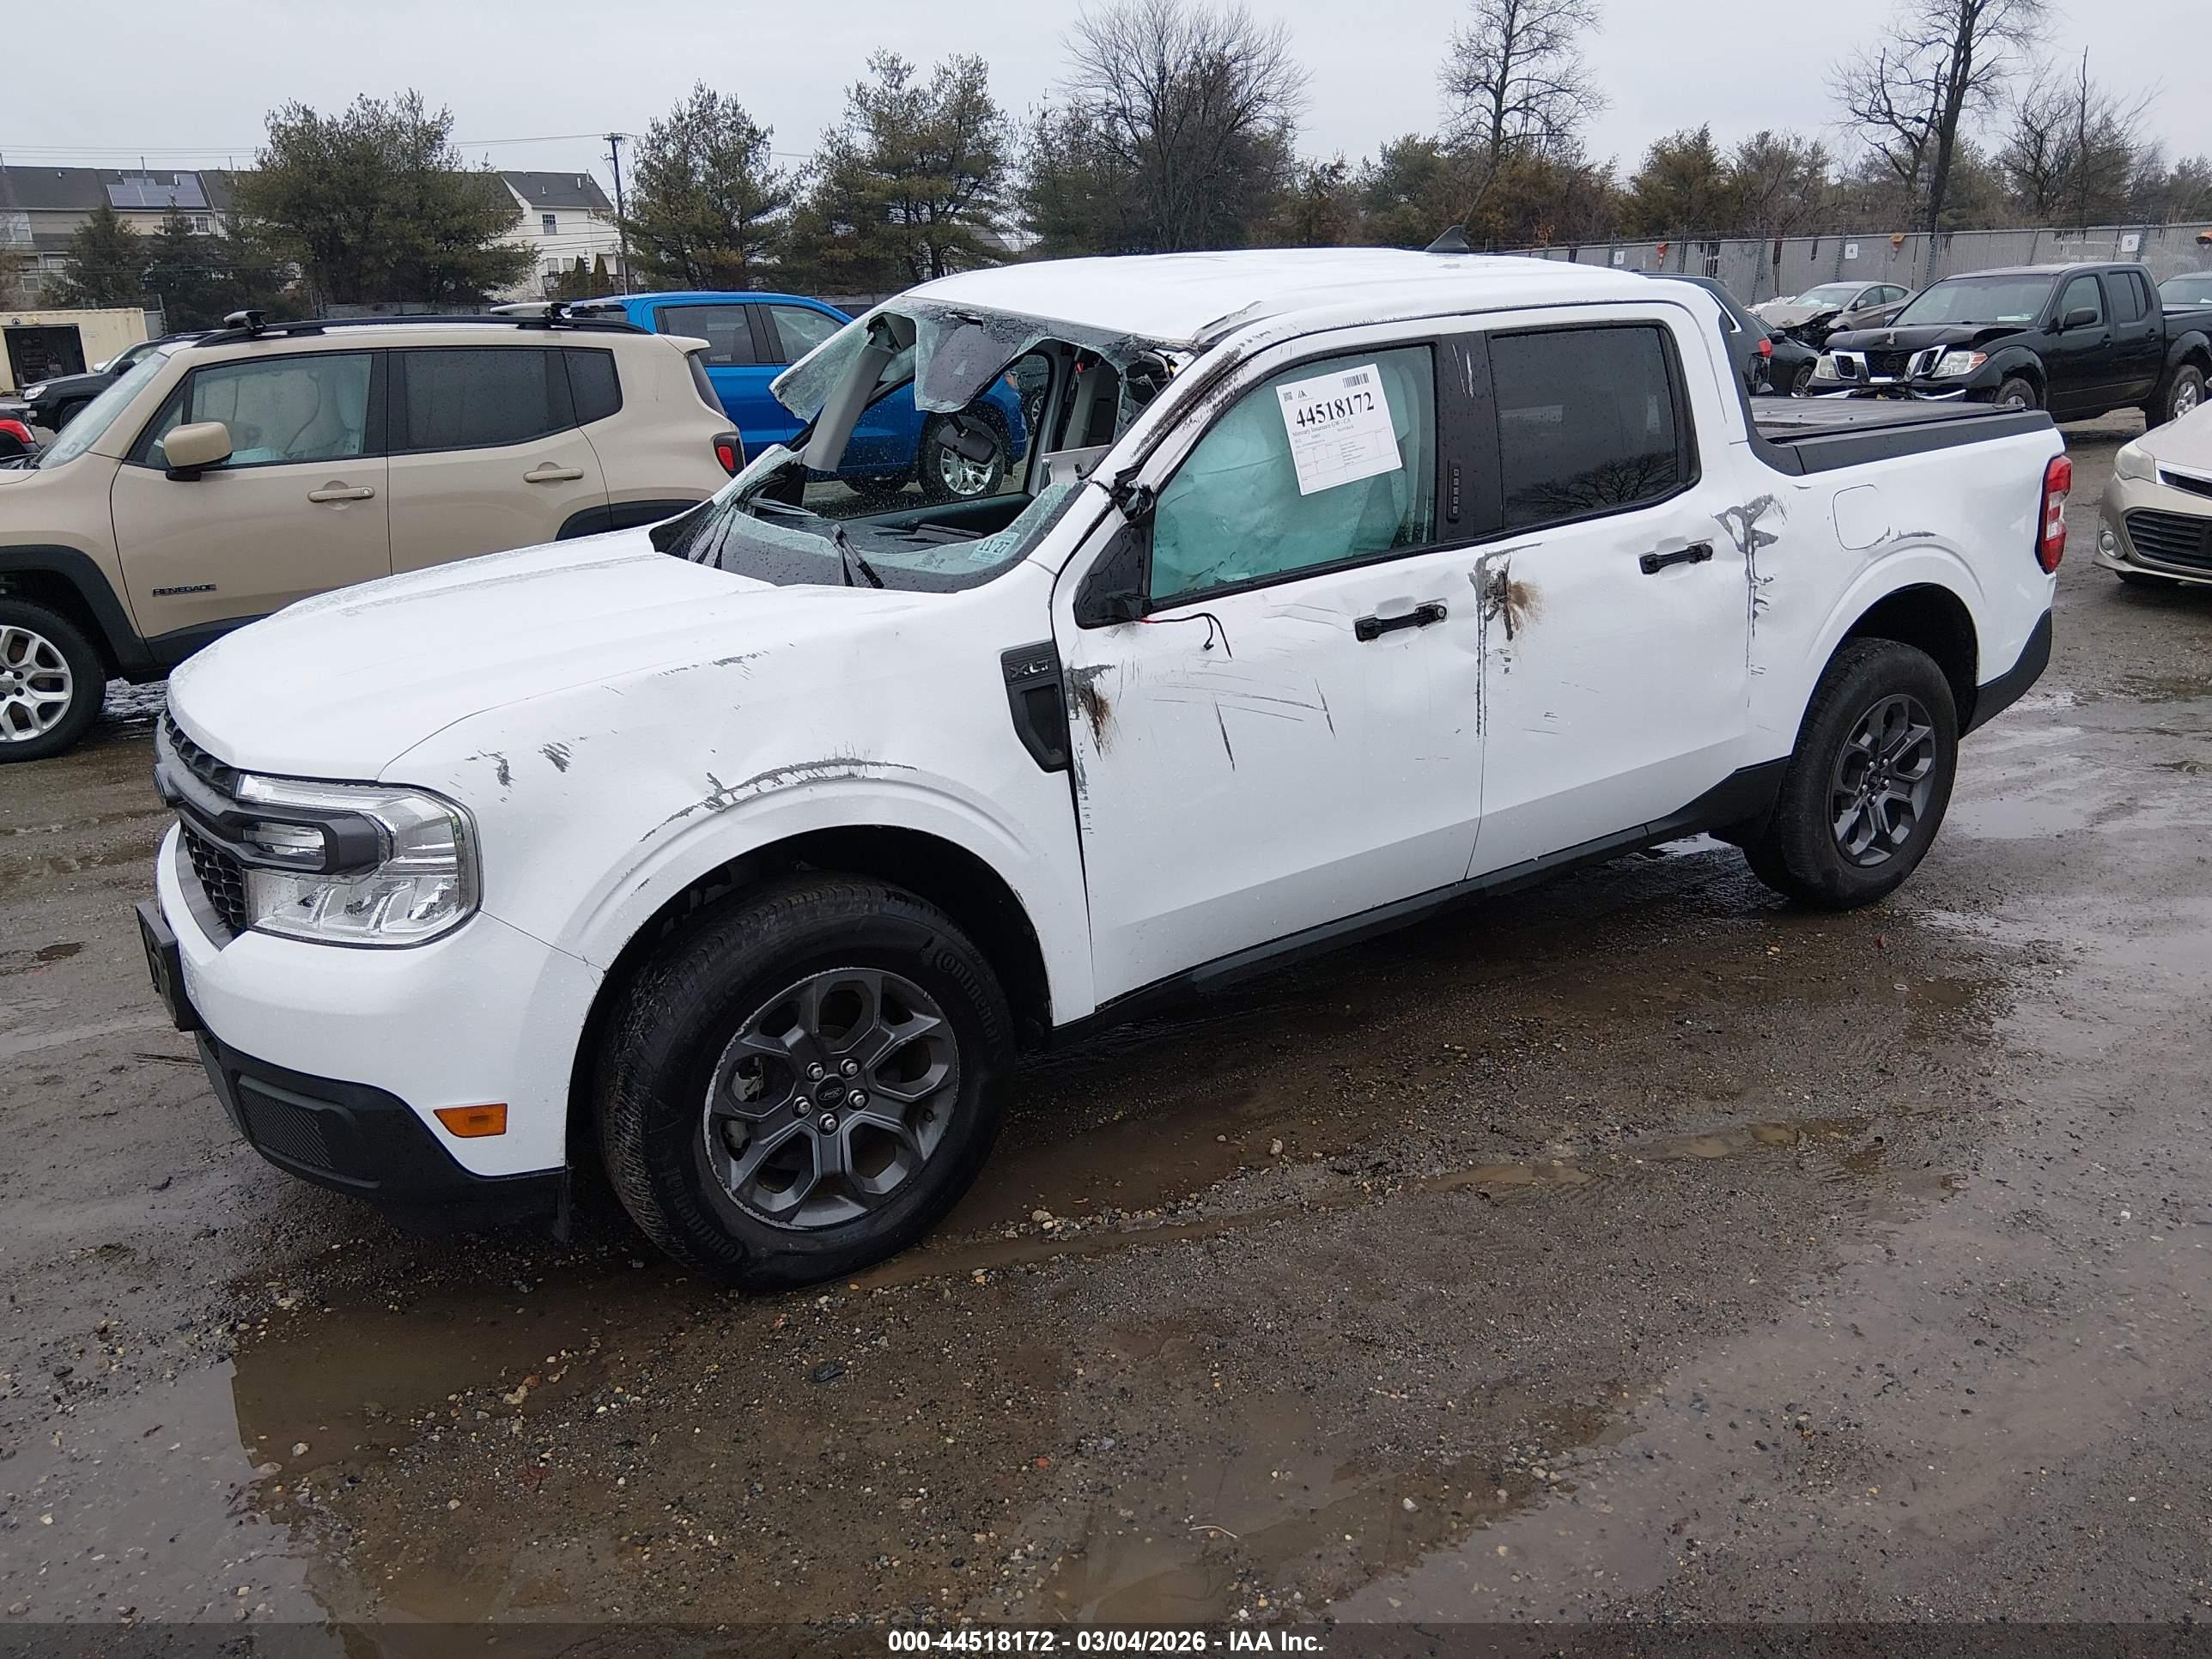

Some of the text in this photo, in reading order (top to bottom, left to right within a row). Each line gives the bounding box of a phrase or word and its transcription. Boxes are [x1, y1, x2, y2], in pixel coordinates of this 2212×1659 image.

[1296, 392, 1375, 428] 44518172
[152, 584, 216, 597] RENEGADE
[1010, 659, 1052, 678] XLT
